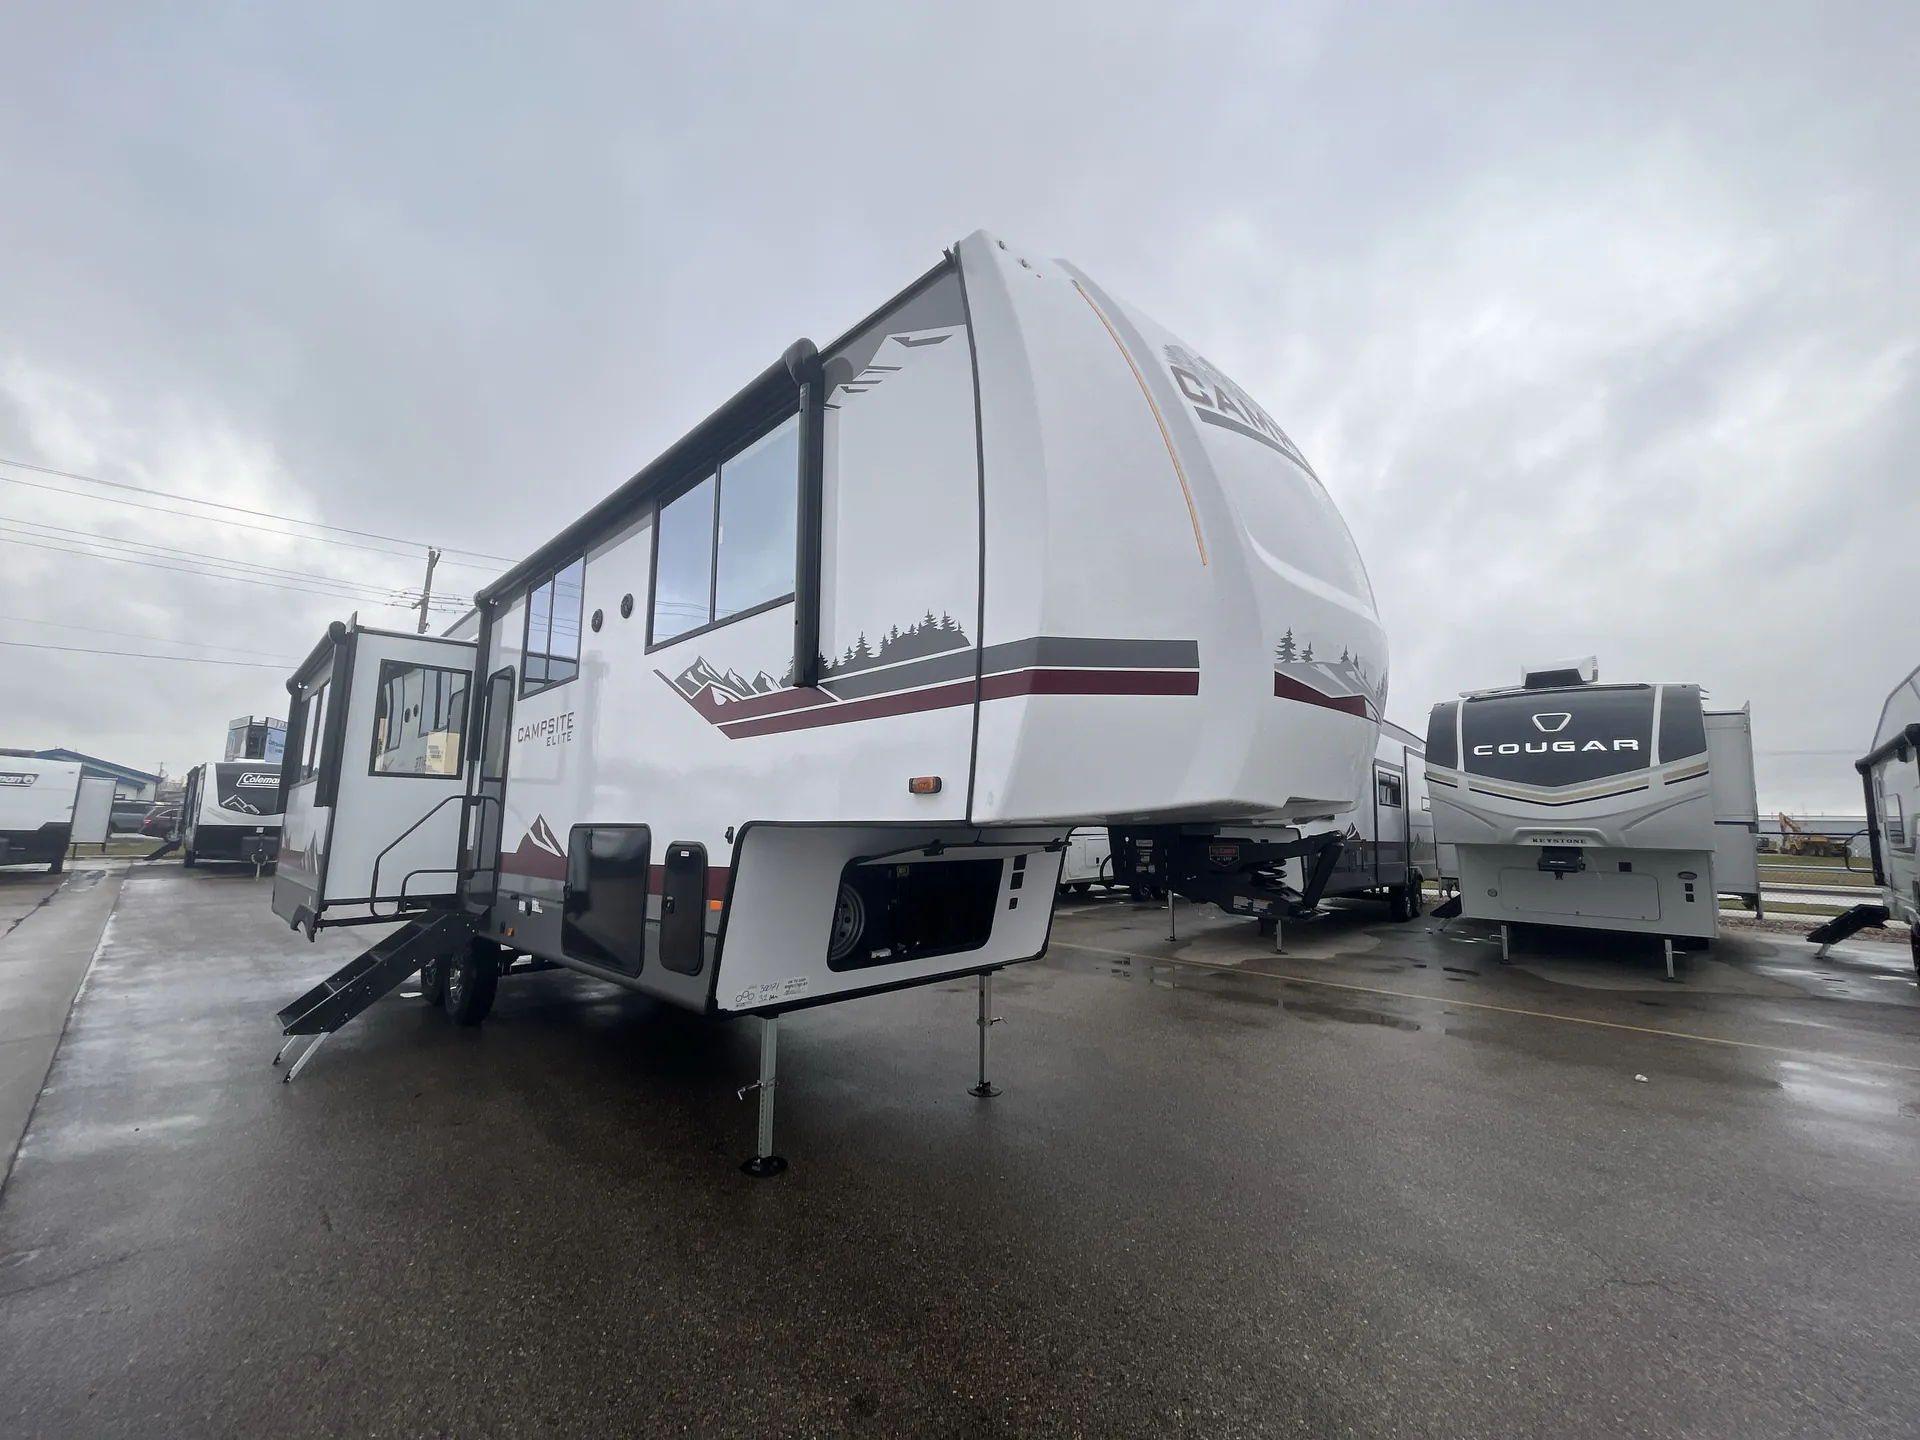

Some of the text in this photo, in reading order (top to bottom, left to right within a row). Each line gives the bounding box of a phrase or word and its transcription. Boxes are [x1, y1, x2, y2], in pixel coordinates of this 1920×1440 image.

[517, 712, 575, 743] CAMPSITE
[546, 731, 573, 747] ELITE
[1473, 739, 1639, 756] COUGAR
